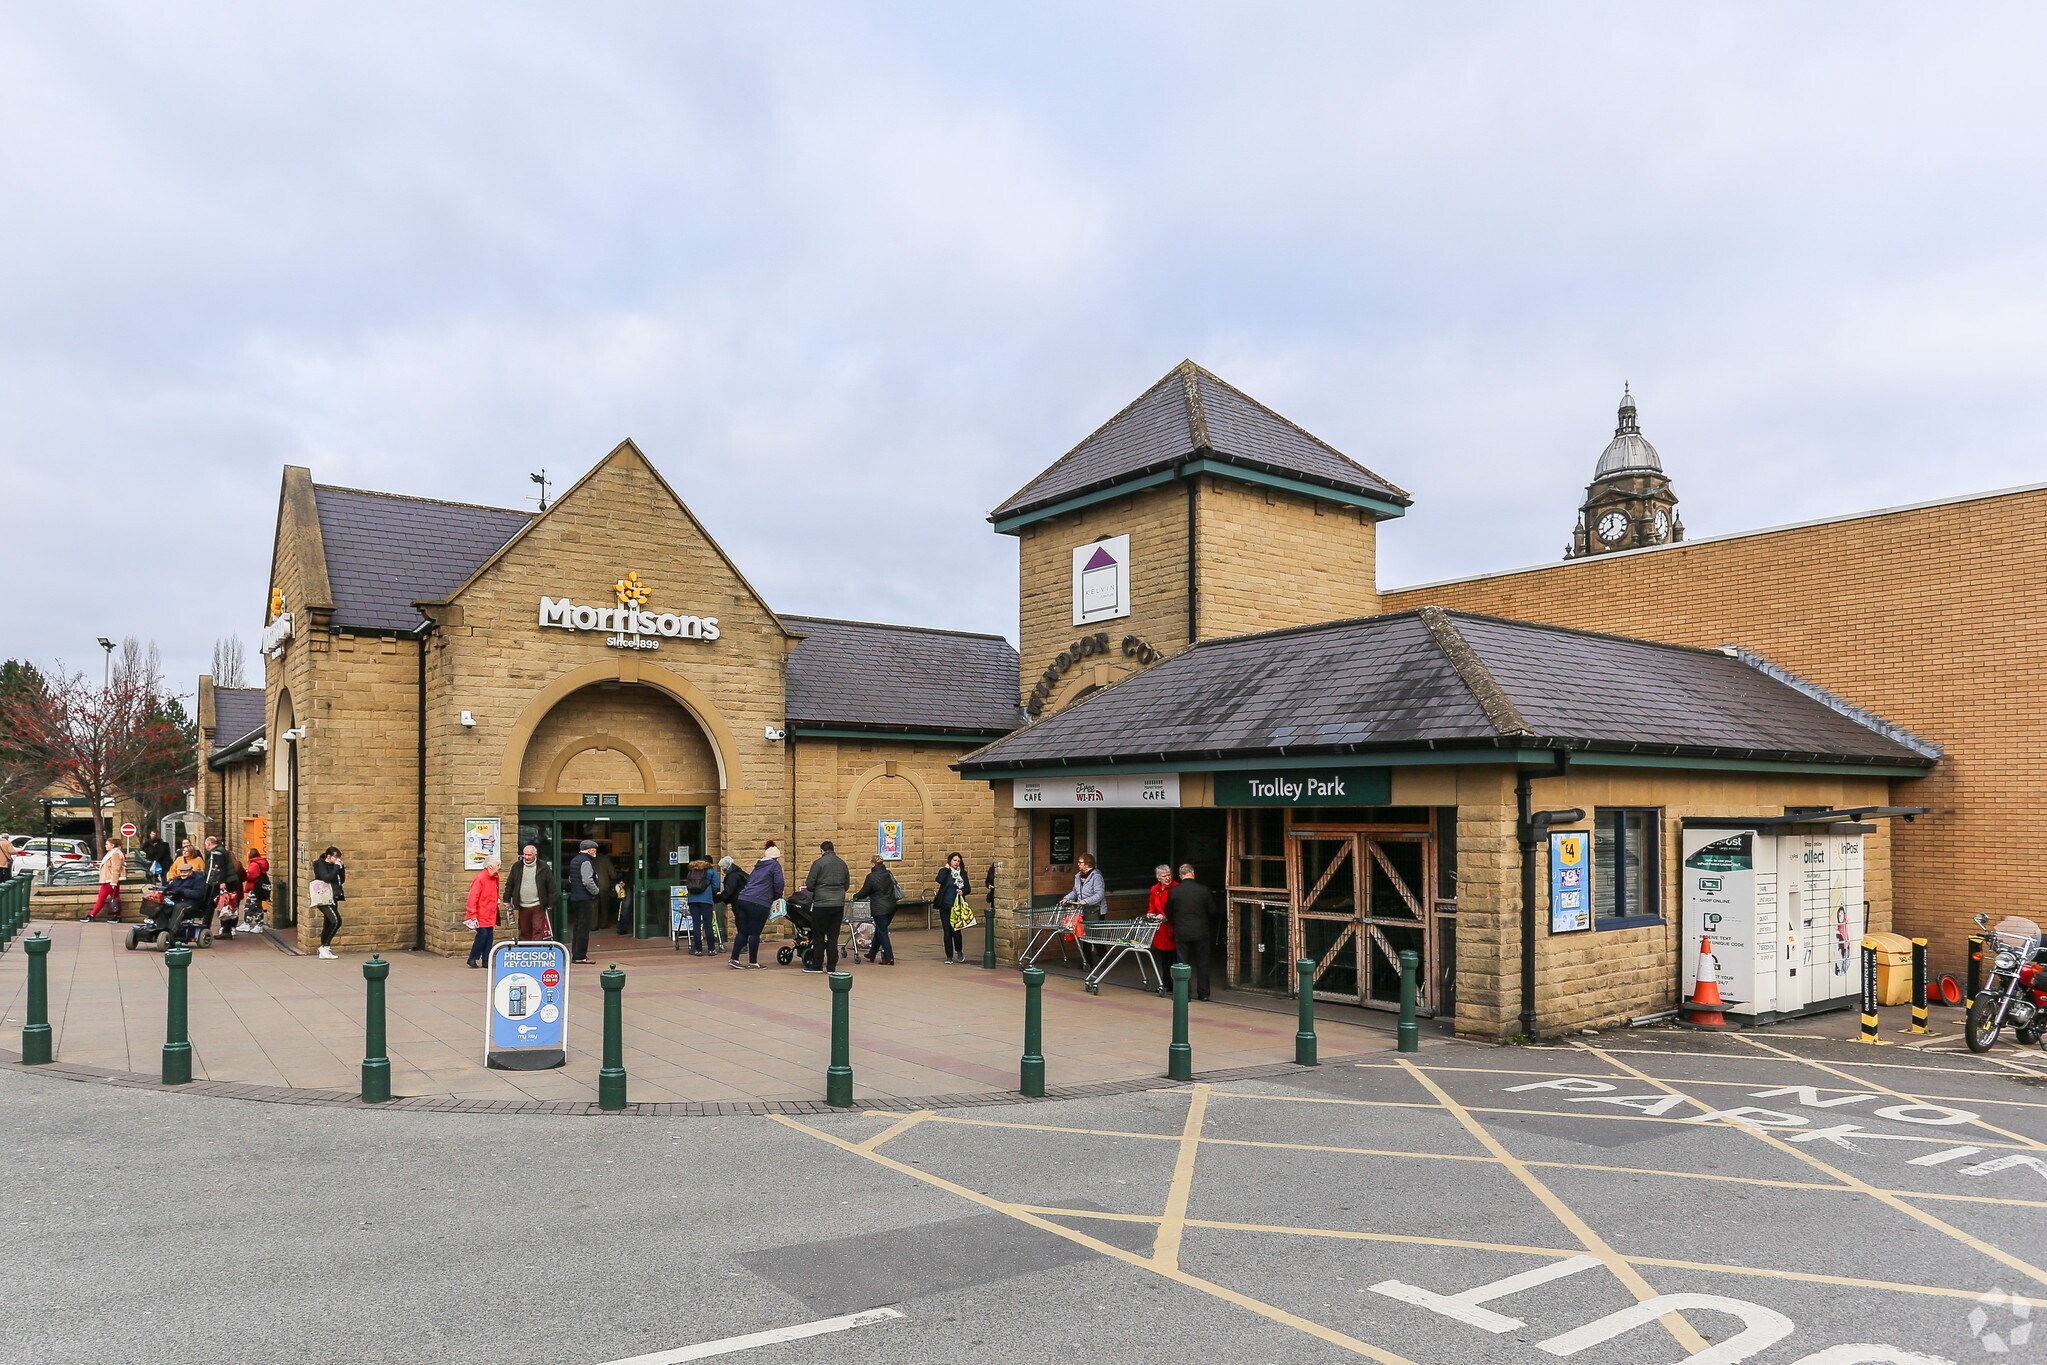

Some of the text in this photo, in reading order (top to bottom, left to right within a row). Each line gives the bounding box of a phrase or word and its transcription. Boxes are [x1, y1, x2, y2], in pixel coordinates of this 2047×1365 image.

[1085, 584, 1115, 596] KELVIN
[539, 596, 721, 640] Morrisons
[606, 637, 660, 650] Since 1899
[1027, 632, 1109, 716] WINDSOR
[1076, 782, 1096, 794] Free
[1142, 789, 1166, 800] CAFÉ
[1248, 775, 1346, 802] Trolley Park
[1024, 792, 1042, 802] CAFÉ
[1076, 793, 1096, 802] WI-FI
[1565, 843, 1575, 858] £4
[1841, 842, 1859, 855] InPost
[1803, 850, 1825, 864] ollect
[504, 951, 556, 960] PRECISION
[503, 960, 556, 968] KEY CUTTING
[1747, 1086, 1981, 1125] NO
